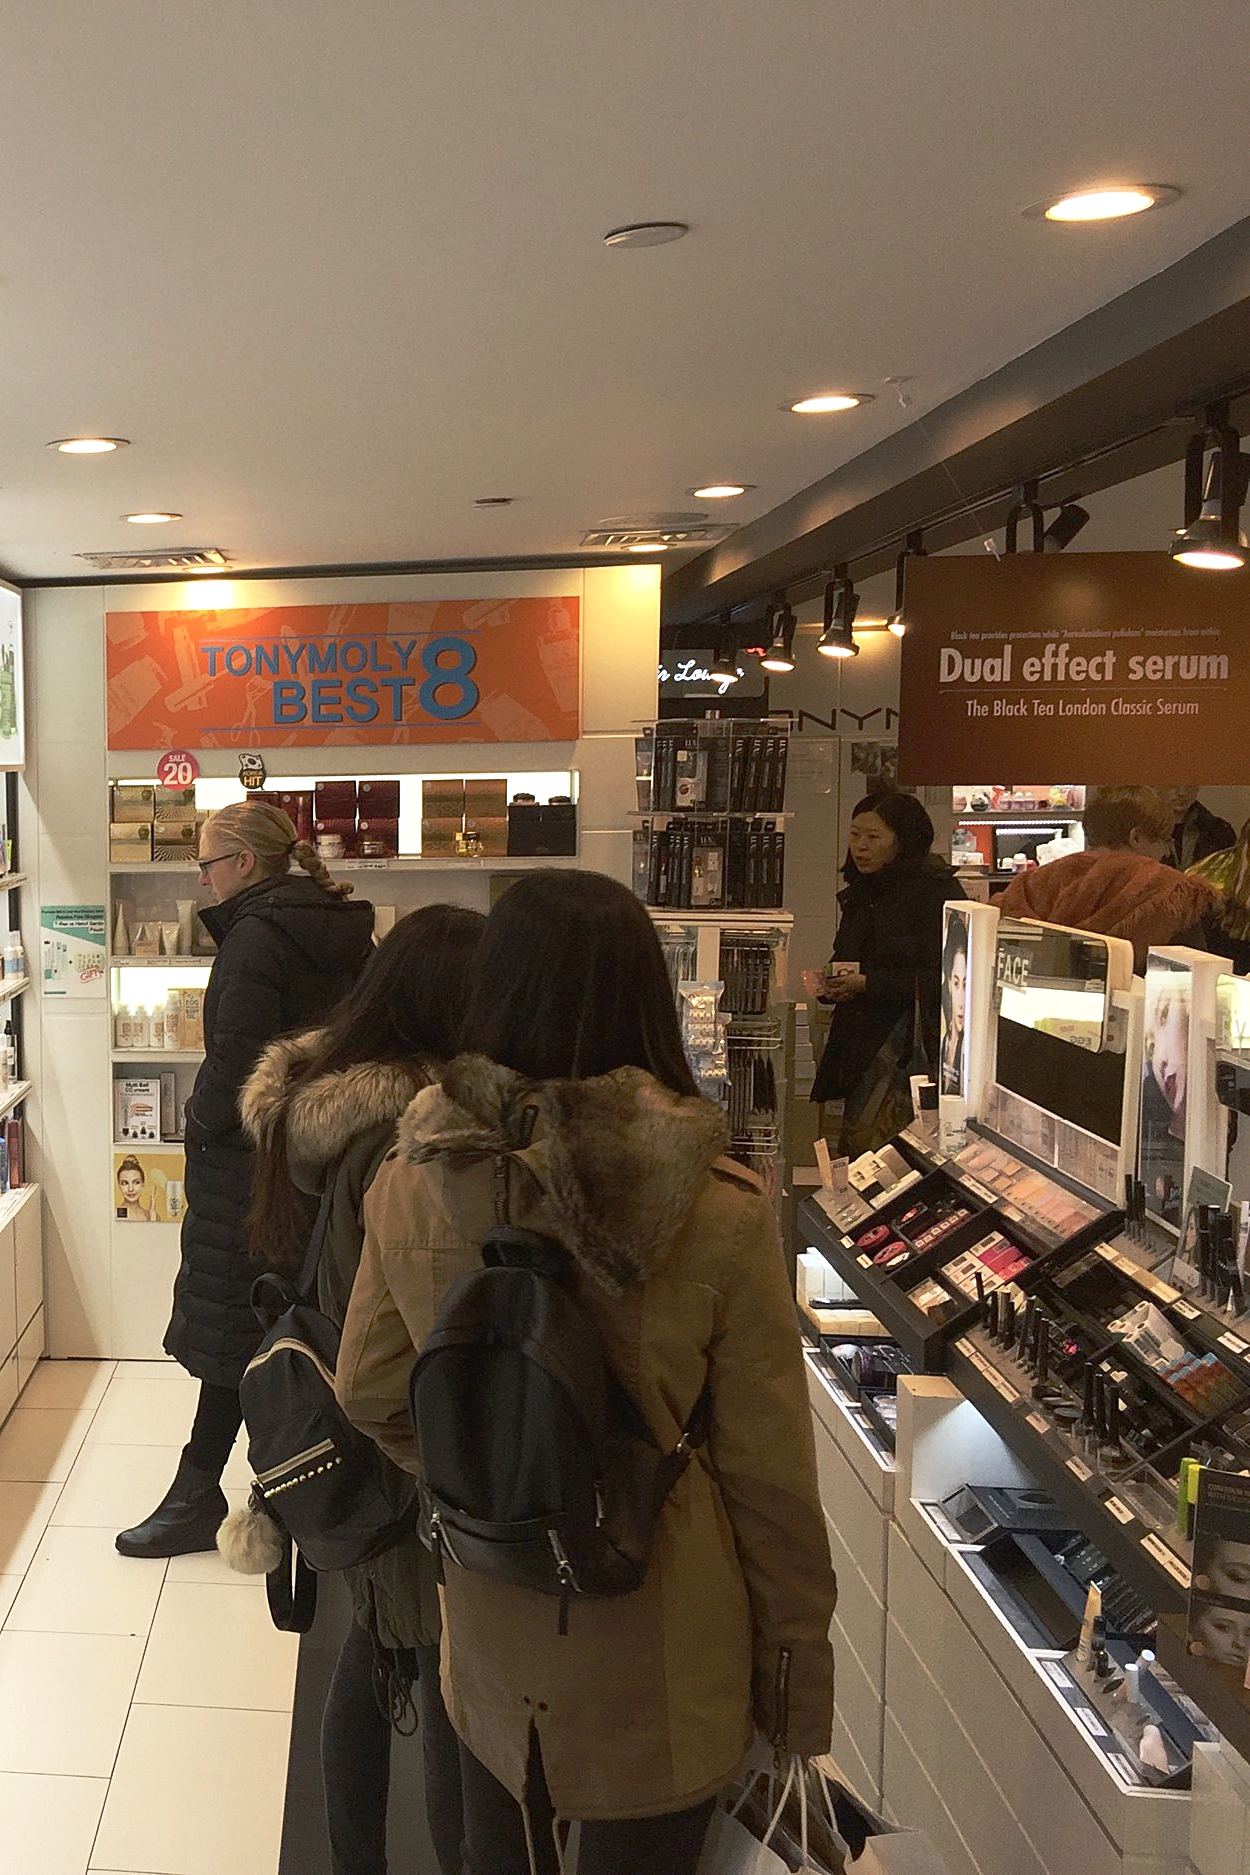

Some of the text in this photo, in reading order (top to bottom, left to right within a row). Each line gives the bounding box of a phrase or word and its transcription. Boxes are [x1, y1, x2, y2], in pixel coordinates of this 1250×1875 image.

[200, 640, 417, 677] TONYMOLY
[939, 643, 1229, 682] Dual effect serum
[273, 637, 479, 724] BEST 8
[966, 698, 1199, 716] The Black Tea London Classic Serum
[168, 754, 186, 762] SALE
[163, 762, 192, 785] 20
[243, 775, 263, 786] HIT
[997, 951, 1030, 987] FACE
